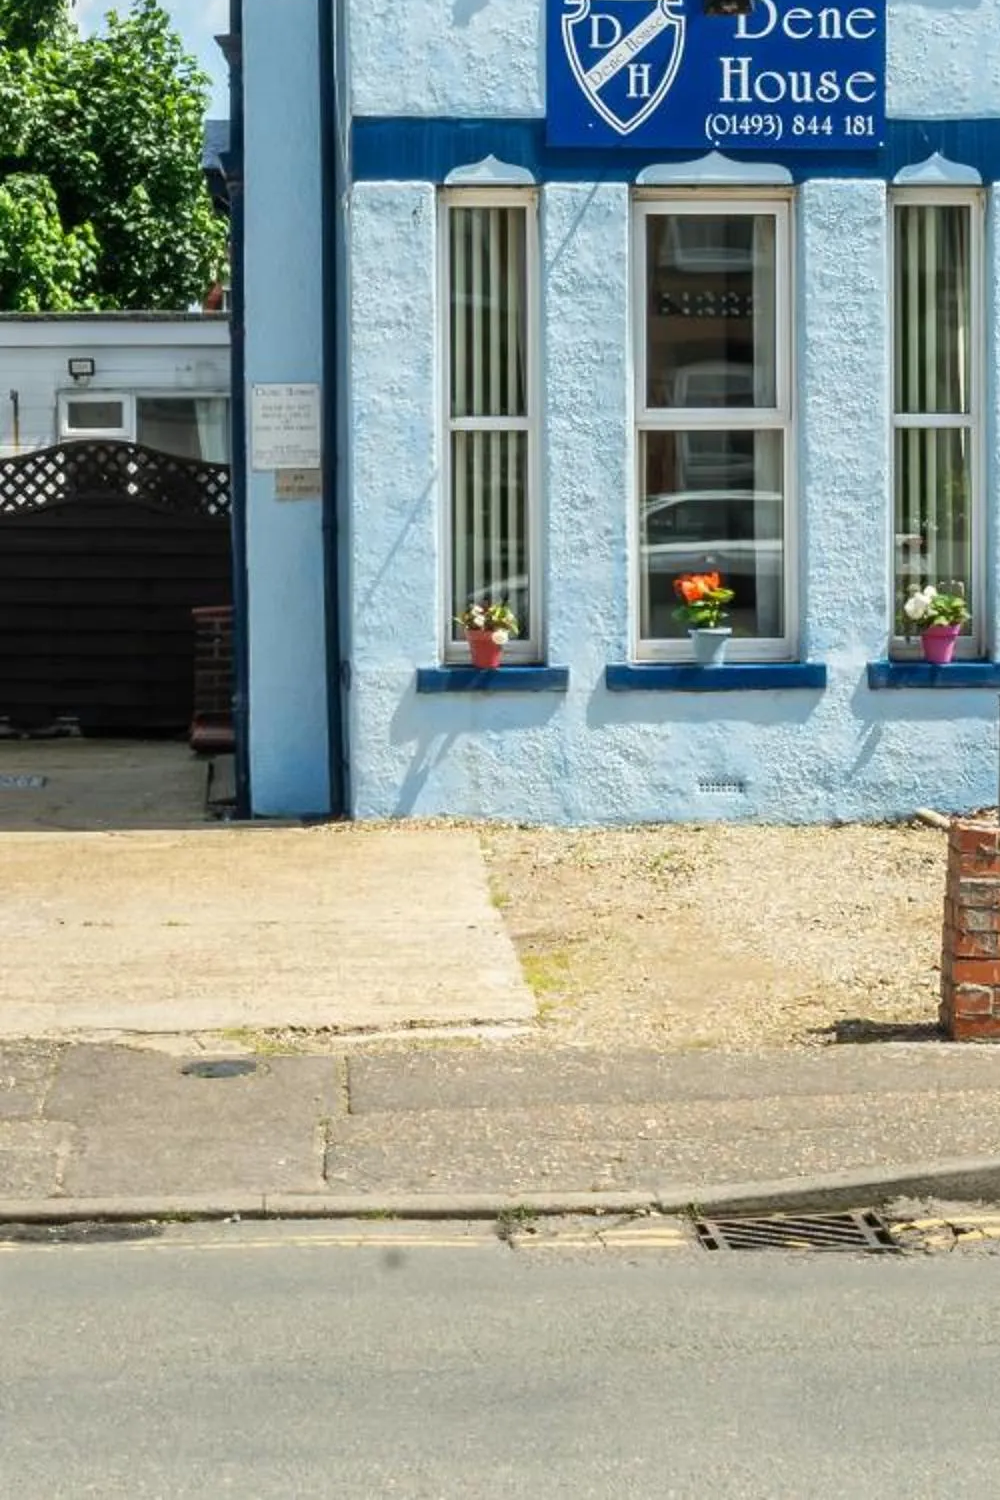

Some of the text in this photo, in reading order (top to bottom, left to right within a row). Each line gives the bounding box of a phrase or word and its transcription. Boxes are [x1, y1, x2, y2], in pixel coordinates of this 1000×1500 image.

[589, 14, 622, 49] D
[626, 63, 653, 98] H
[719, 56, 877, 103] House
[705, 113, 875, 141] (01493) 844 181
